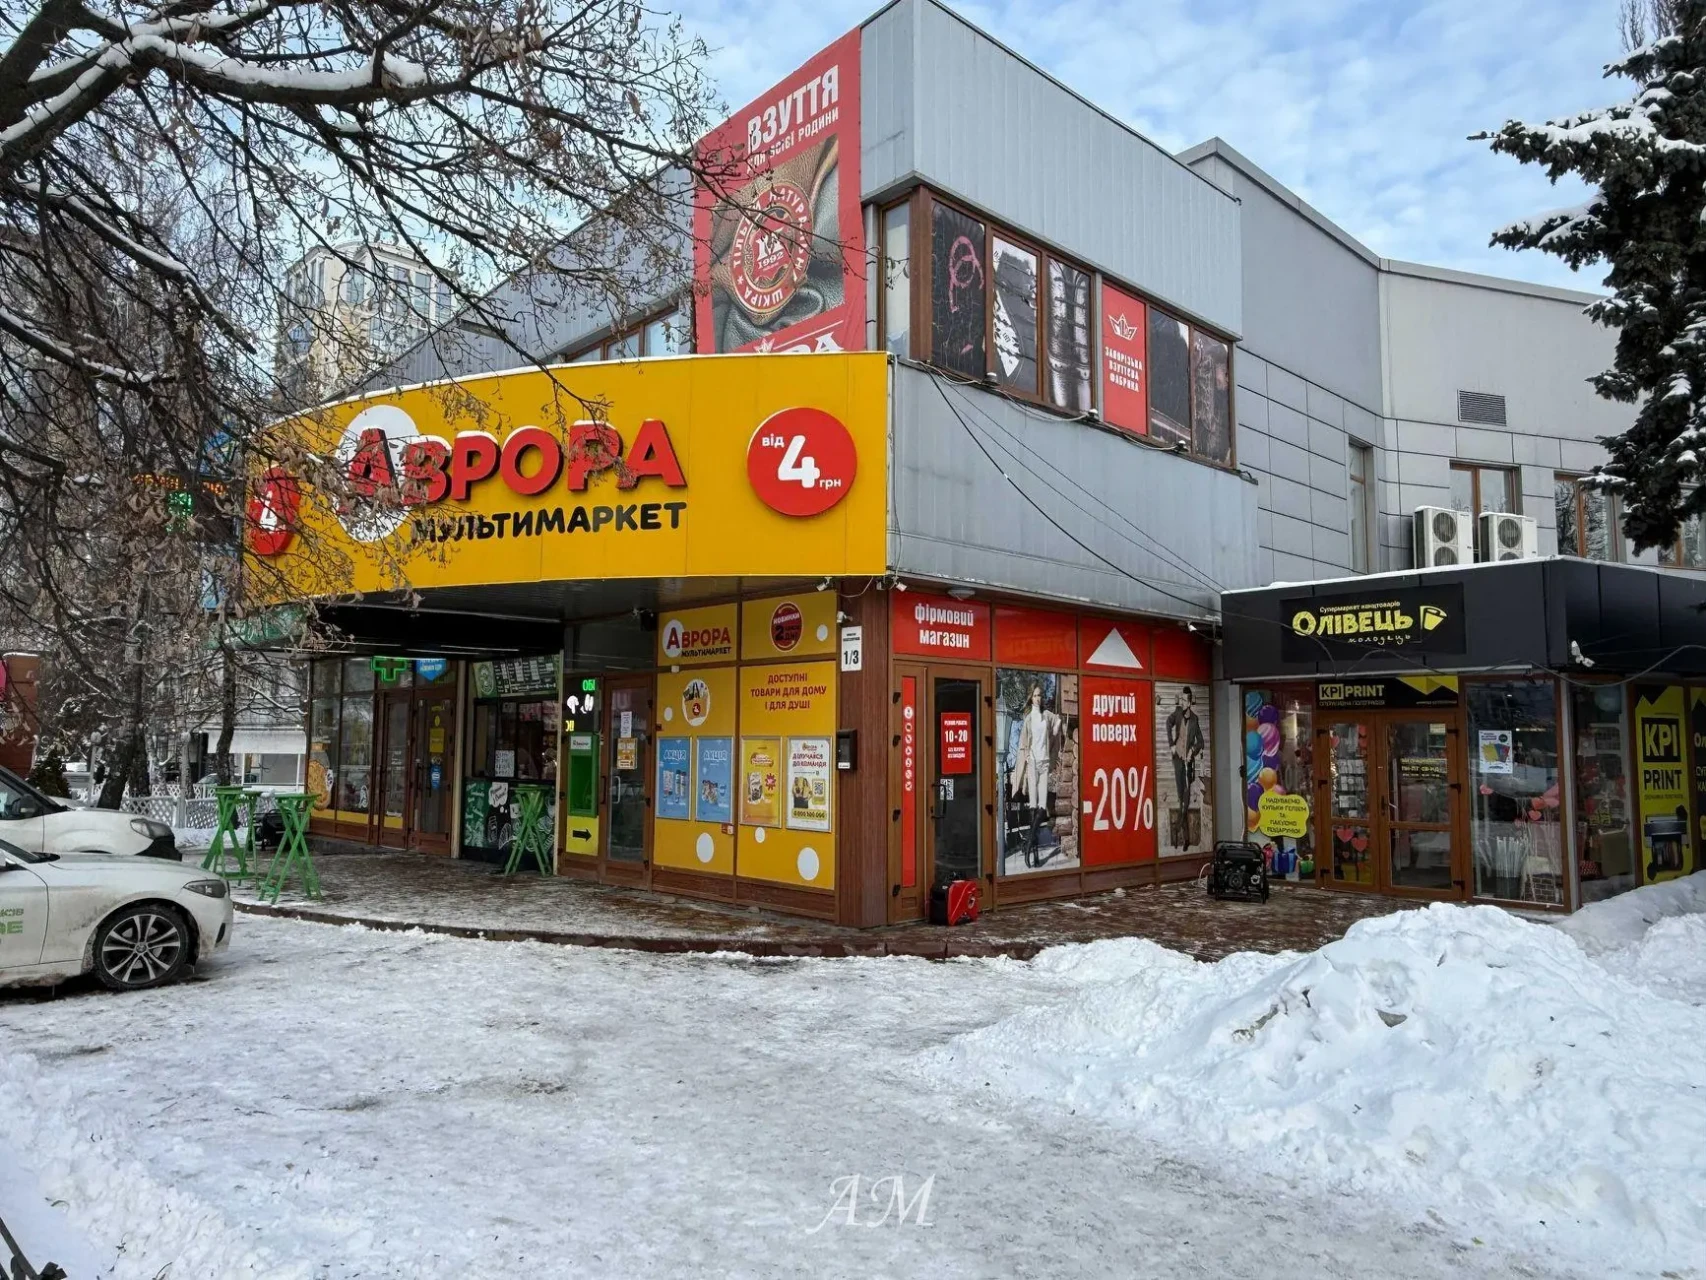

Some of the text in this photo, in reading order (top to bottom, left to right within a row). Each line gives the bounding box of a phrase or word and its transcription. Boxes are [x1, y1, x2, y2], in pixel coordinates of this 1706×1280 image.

[747, 64, 839, 155] ВЗУТТЯ
[798, 107, 839, 142] РОДИНИ
[757, 251, 785, 270] 1992
[335, 419, 688, 514] АВРОРА
[762, 433, 842, 490] від 4 грн
[410, 502, 688, 543] МУЛЬТИМАРКЕТ
[914, 603, 974, 626] фірмовий
[666, 627, 732, 650] АВРОРА
[919, 629, 970, 648] магазин
[843, 649, 860, 665] 1/3
[768, 673, 808, 685] ДОСТУПНІ
[750, 685, 827, 698] ТОВАРИ ДЛЯ ДОМУ
[1320, 684, 1385, 698] KPI PRINT
[769, 701, 787, 711] ДЛЯ
[788, 700, 811, 711] ДУШІ
[1092, 692, 1136, 717] другий
[1092, 723, 1137, 746] поверх
[1644, 723, 1679, 757] KPI
[1643, 769, 1683, 791] PRINT
[1083, 765, 1153, 831] -20%
